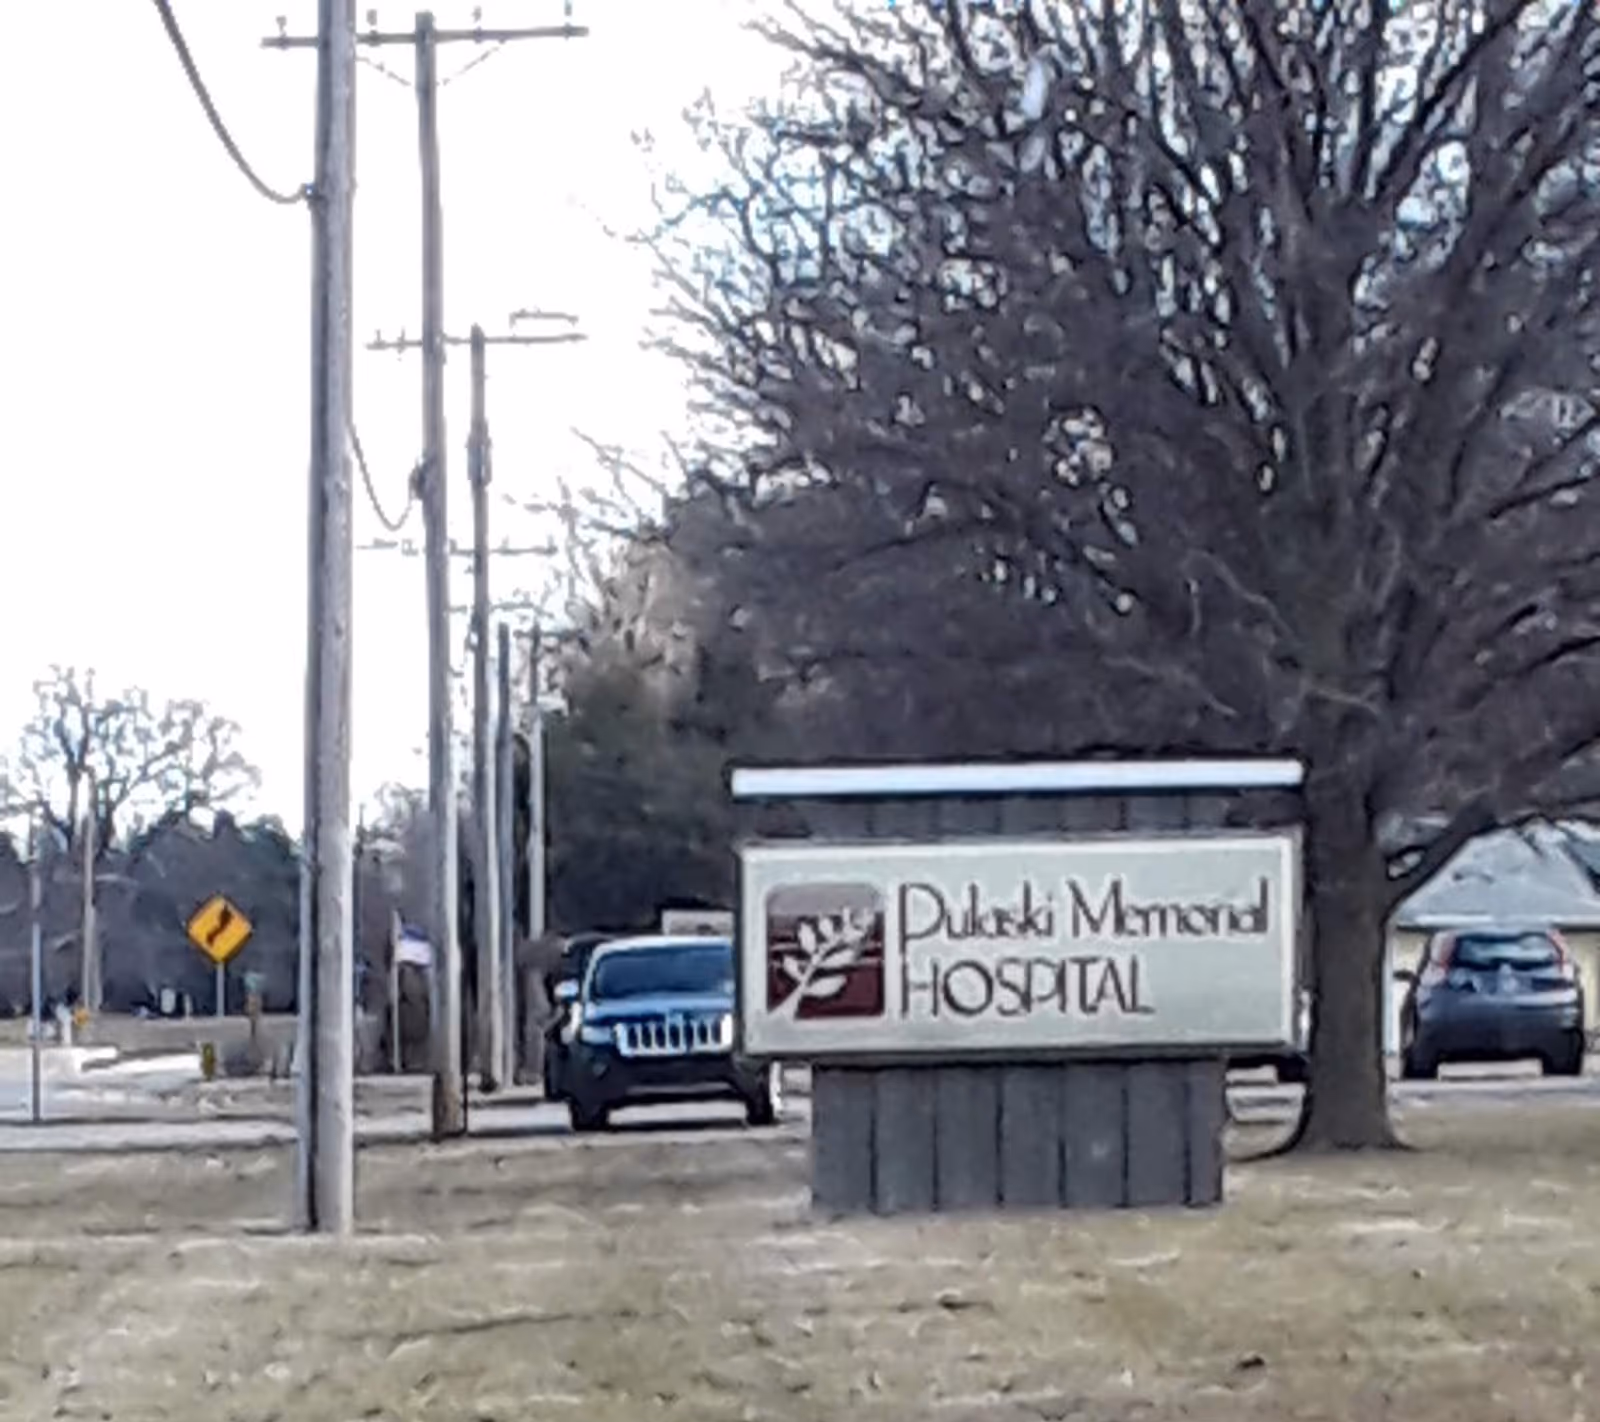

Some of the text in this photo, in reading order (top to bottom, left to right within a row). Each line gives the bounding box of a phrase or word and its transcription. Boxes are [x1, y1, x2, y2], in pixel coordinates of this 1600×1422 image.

[899, 876, 1268, 953] Pulaski Memorial
[901, 955, 1155, 1017] HOSPITAL
